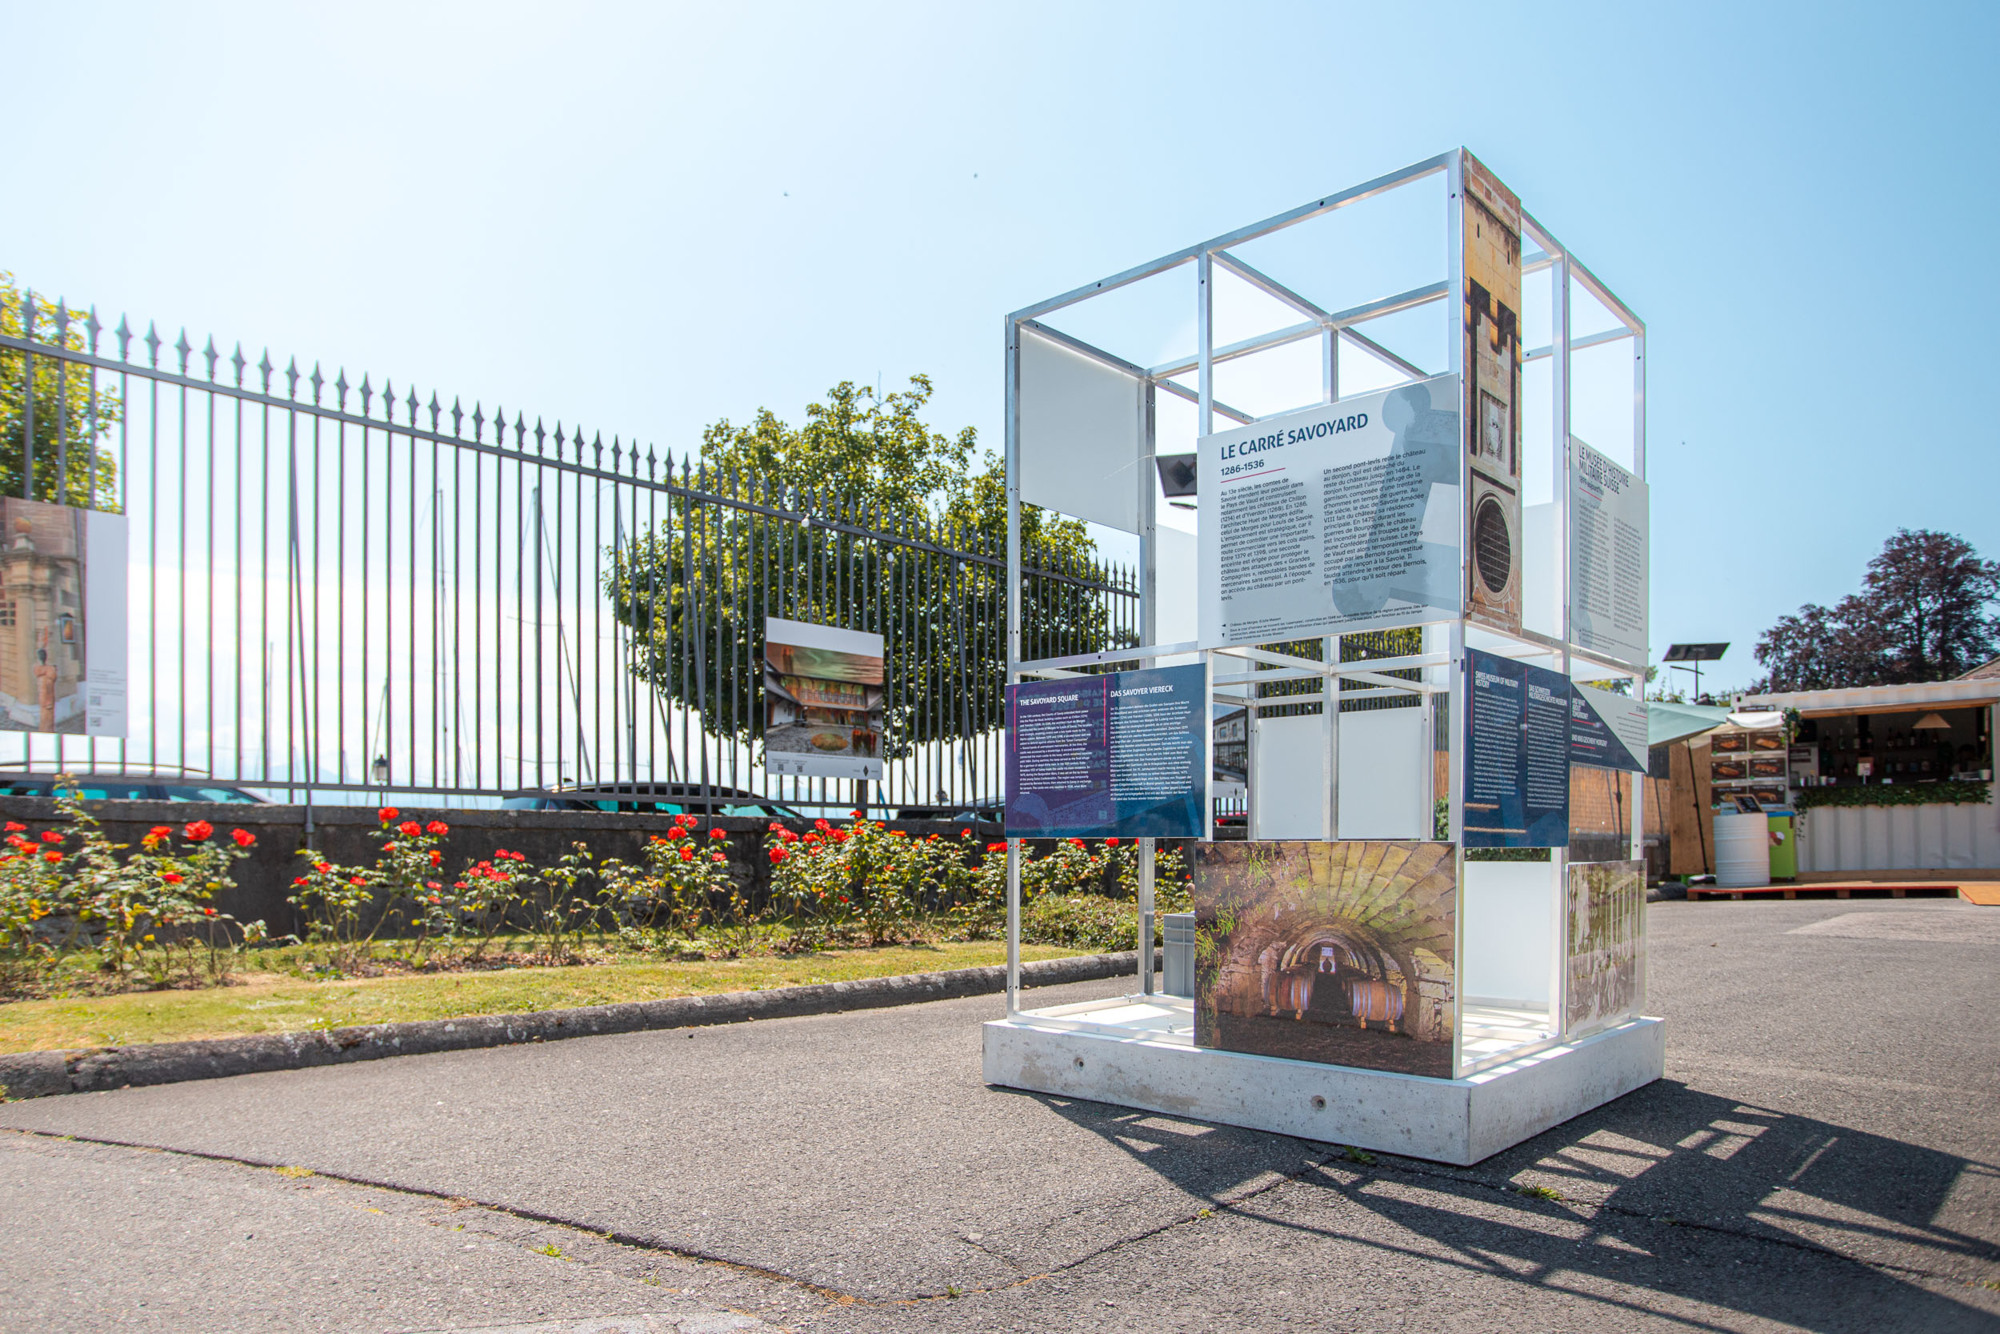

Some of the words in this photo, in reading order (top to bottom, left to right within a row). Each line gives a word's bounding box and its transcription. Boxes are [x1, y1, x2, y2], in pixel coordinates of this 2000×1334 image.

[1221, 444, 1236, 460] LE
[1239, 430, 1284, 456] CARRÉ
[1288, 413, 1368, 445] SAVOYARD
[1579, 444, 1585, 460] LE
[1221, 459, 1265, 476] 1286-1536
[1604, 474, 1620, 494] SUISSE
[1122, 687, 1148, 696] SAVOYER
[1149, 685, 1173, 694] VIERECK
[1030, 696, 1057, 705] SAVOYARD
[1058, 694, 1078, 704] SQUARE
